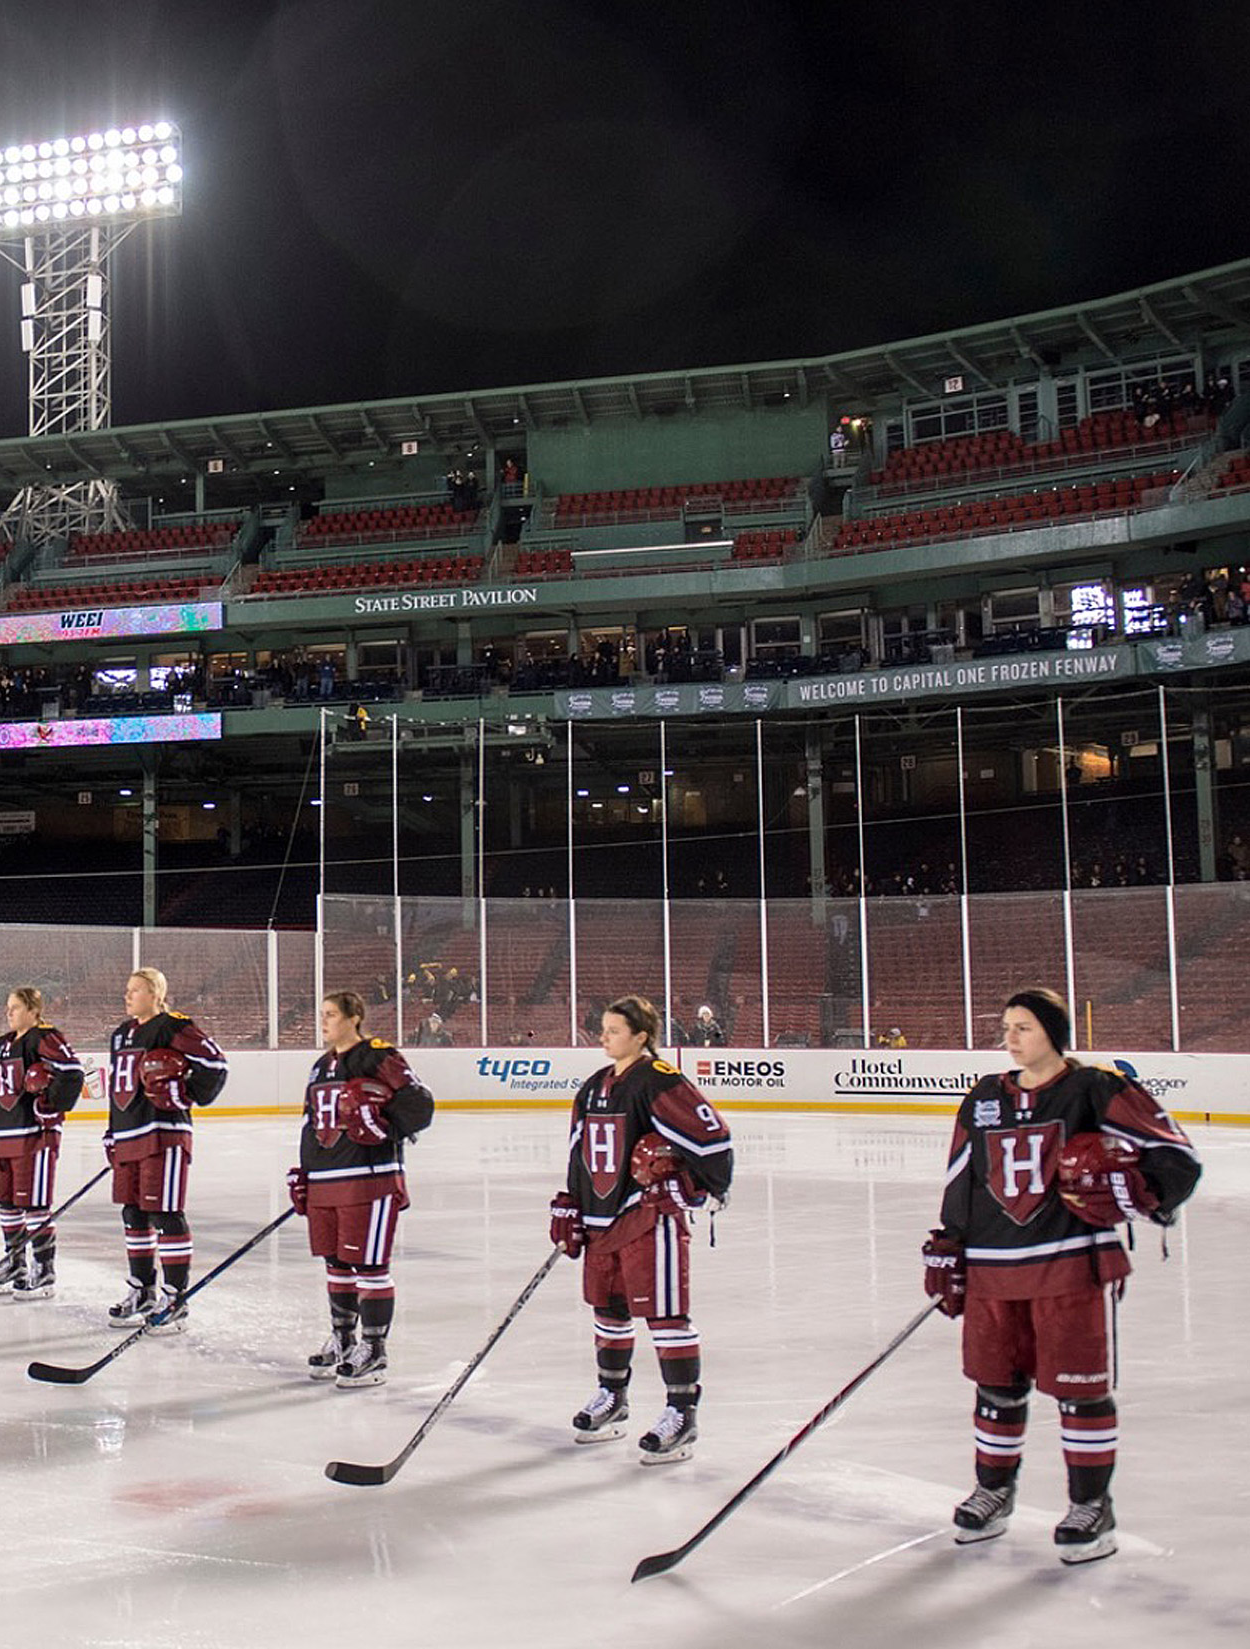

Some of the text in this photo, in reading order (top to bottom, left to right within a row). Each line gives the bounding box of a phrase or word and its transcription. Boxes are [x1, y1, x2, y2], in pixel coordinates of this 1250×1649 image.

[354, 588, 538, 613] STATE STREET PAVILION
[60, 612, 103, 628] WEEI
[800, 654, 1118, 700] WELCOME TO CAPITAL ONE FROZEN FENWAY
[114, 1055, 135, 1093] H
[476, 1056, 551, 1082] tyco
[715, 1060, 785, 1077] ENEOS
[851, 1058, 903, 1075] Hotel
[510, 1078, 567, 1090] Integrated
[698, 1077, 786, 1088] THE MOTOR OIL
[316, 1089, 339, 1130] H
[695, 1102, 720, 1132] 9
[589, 1123, 616, 1173] H
[1001, 1134, 1045, 1197] H
